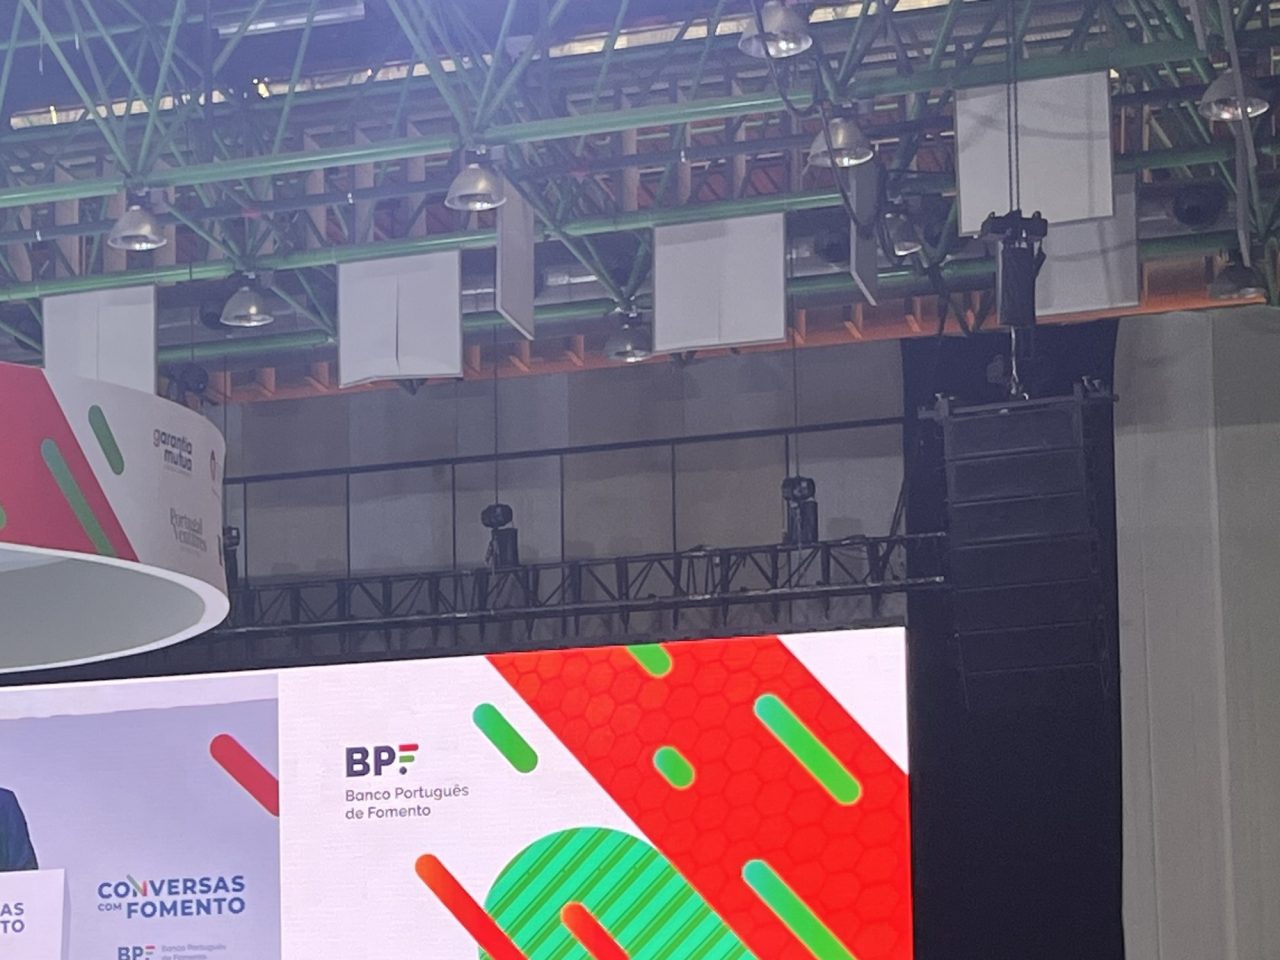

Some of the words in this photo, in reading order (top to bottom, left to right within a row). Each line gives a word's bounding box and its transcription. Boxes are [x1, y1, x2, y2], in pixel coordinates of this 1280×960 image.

[153, 428, 193, 455] garantia
[345, 788, 391, 802] Banco
[394, 784, 469, 801] Português
[345, 807, 364, 820] de
[368, 804, 431, 819] Fomento
[97, 874, 246, 899] CONVERSAS
[97, 902, 122, 912] COM
[126, 896, 246, 919] FOMENTO
